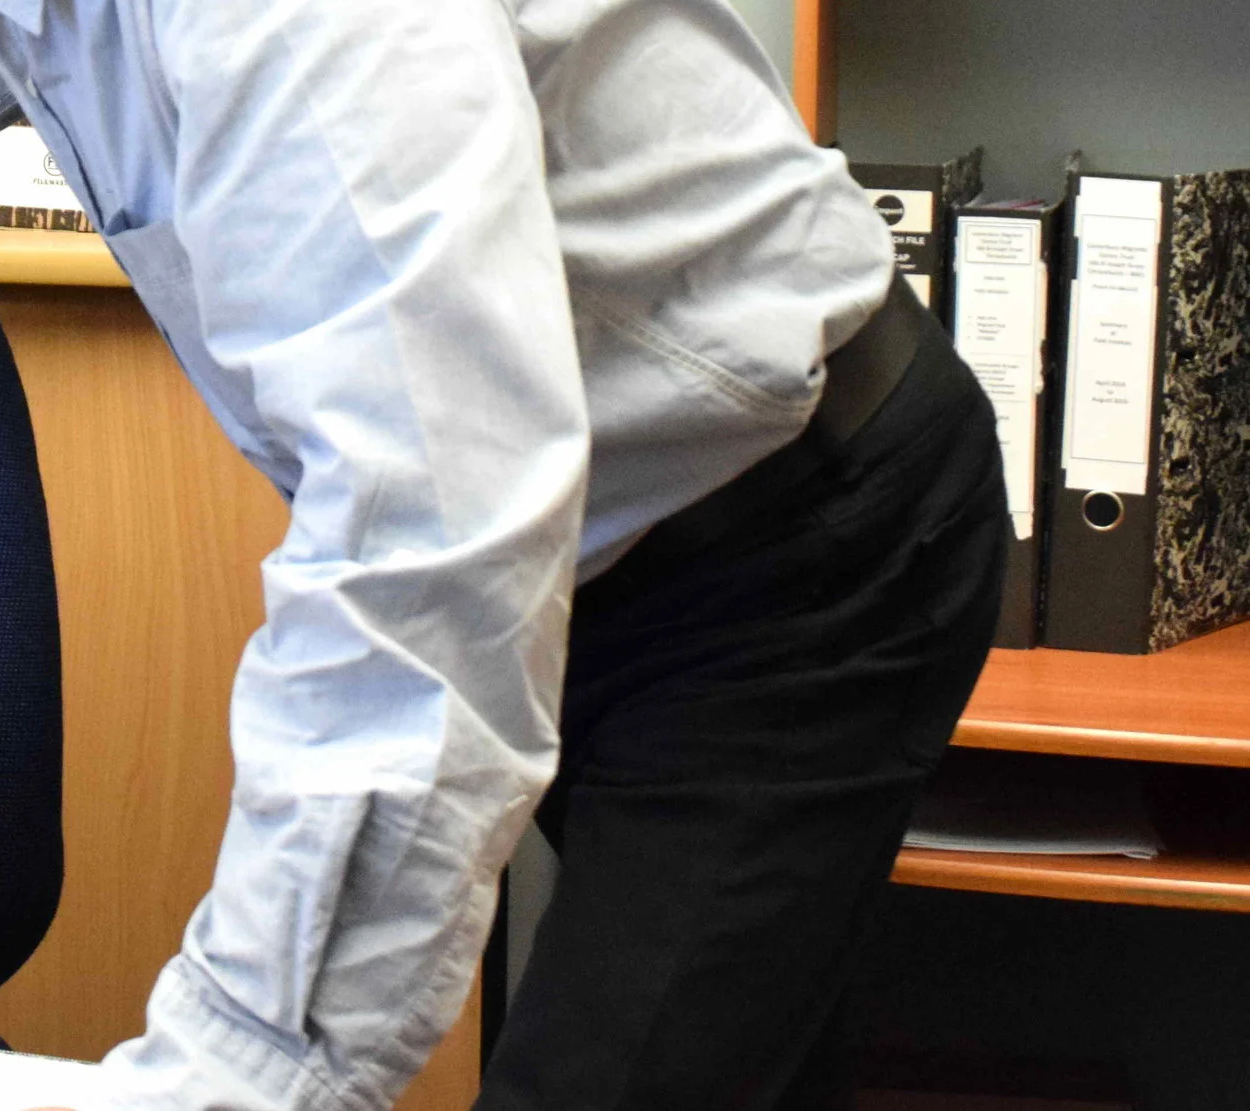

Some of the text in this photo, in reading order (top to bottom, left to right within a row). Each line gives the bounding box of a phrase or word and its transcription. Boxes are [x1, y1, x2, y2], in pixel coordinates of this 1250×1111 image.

[33, 178, 68, 186] FILEMAS
[893, 235, 926, 247] CH FILE
